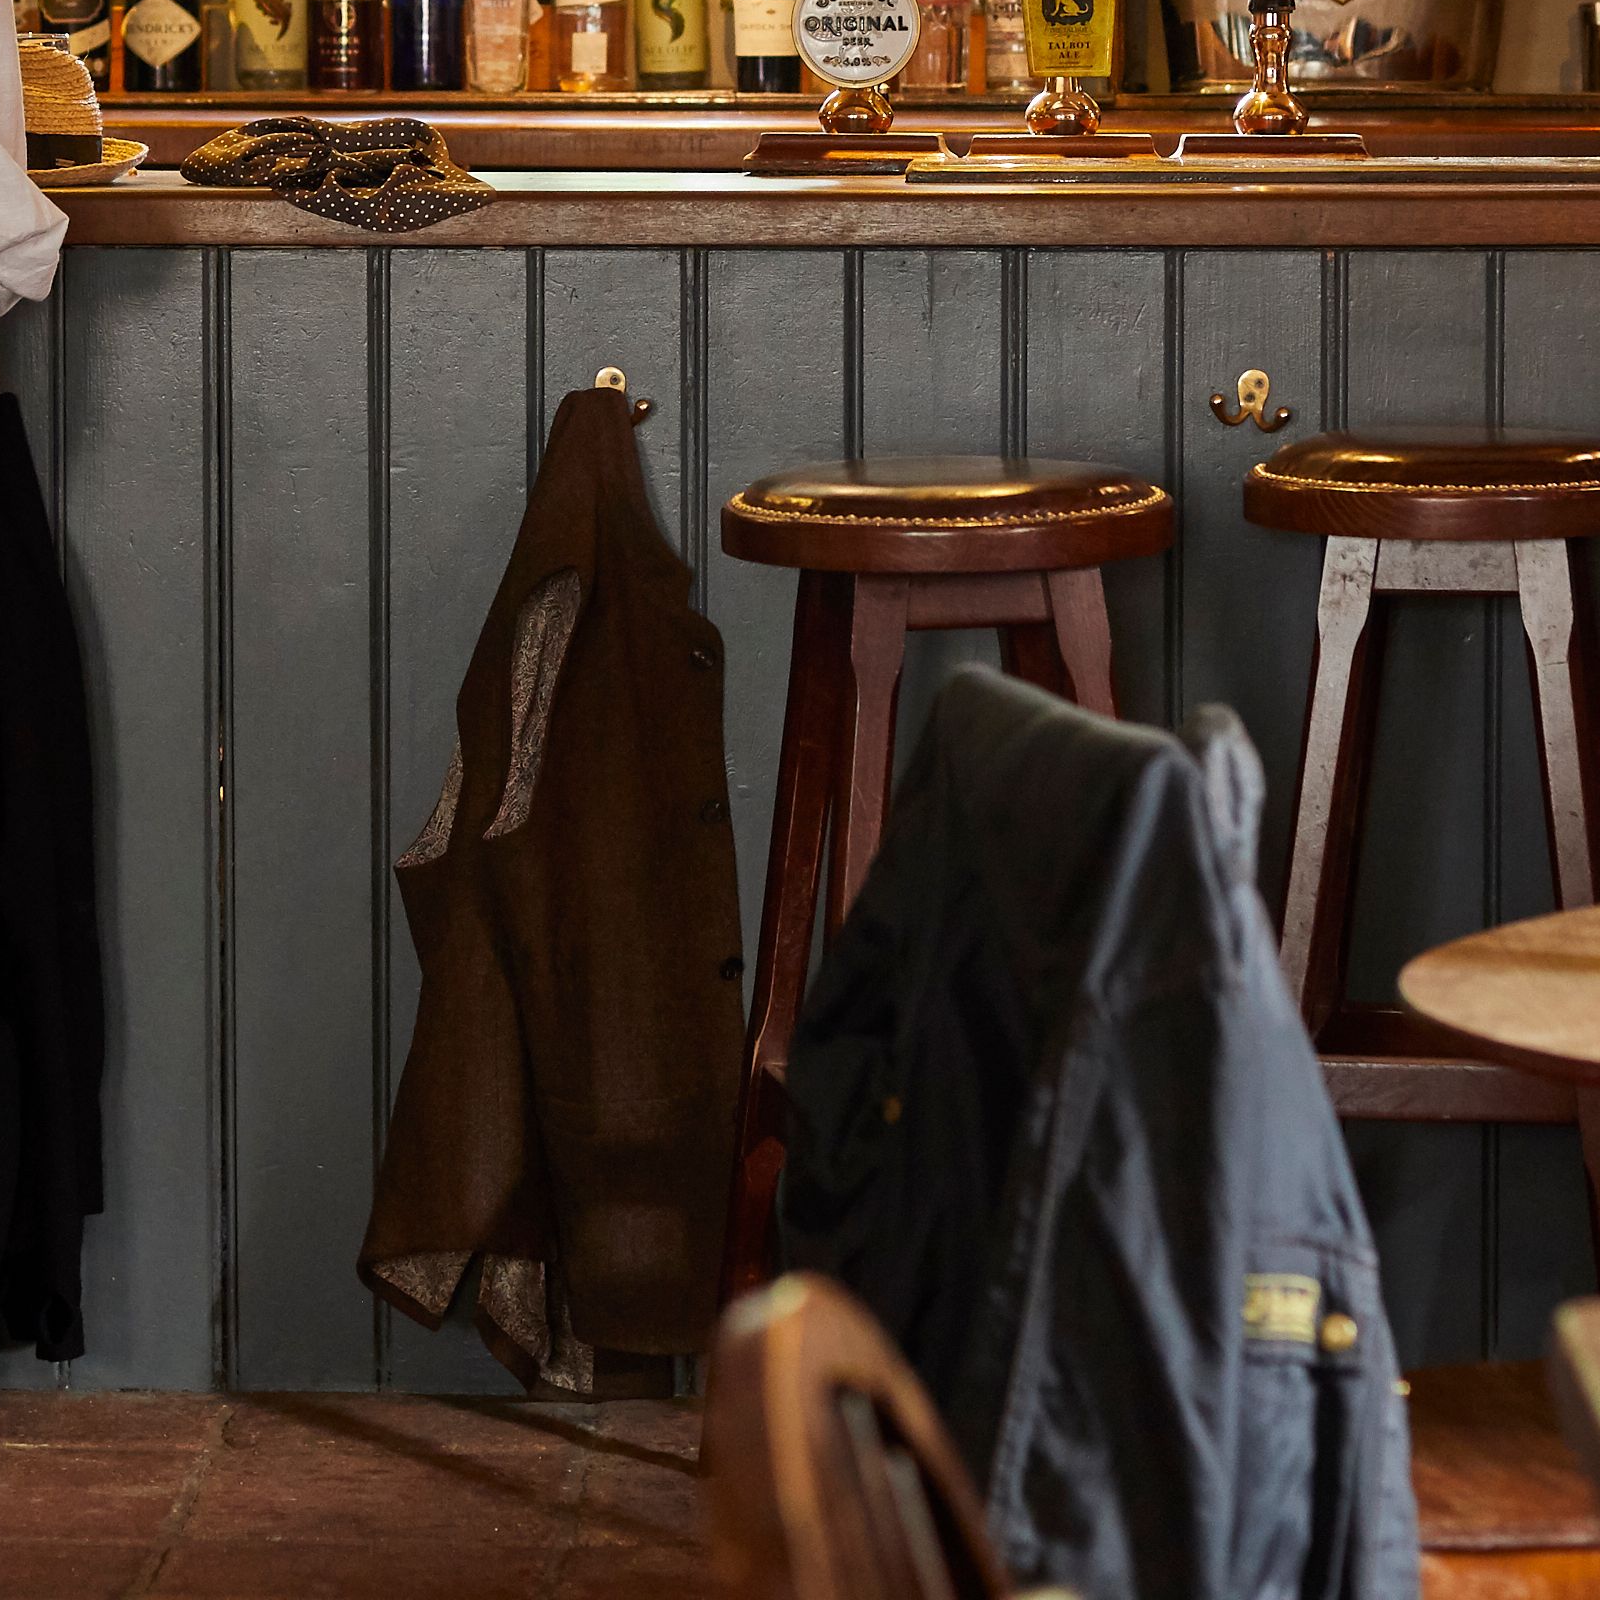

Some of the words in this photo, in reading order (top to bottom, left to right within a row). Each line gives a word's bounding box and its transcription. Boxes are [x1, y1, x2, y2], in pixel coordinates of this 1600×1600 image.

[804, 16, 909, 39] ORIGINAL
[1048, 42, 1091, 50] TALBOT
[1058, 51, 1081, 59] ALE
